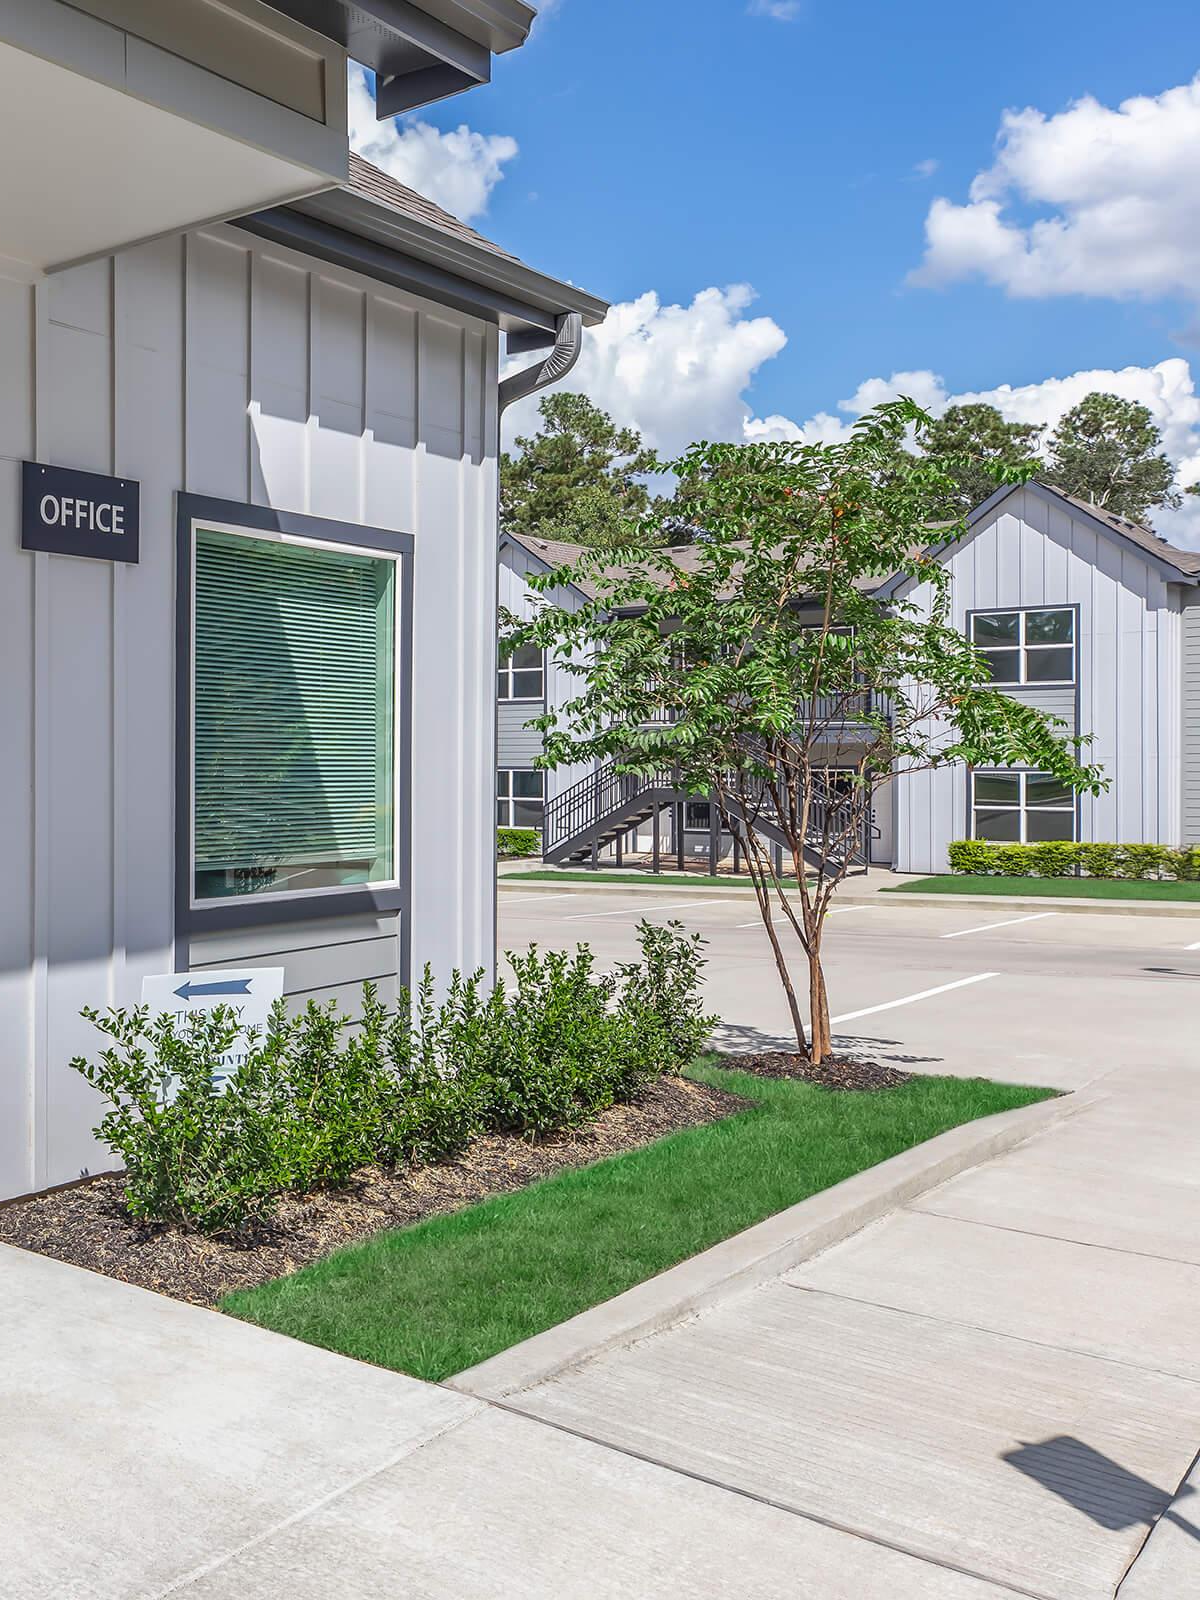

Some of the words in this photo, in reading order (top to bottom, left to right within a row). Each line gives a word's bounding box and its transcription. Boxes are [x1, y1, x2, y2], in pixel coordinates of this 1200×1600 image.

[40, 494, 125, 535] OFFICE
[174, 1008, 207, 1025] THIS
[172, 1029, 197, 1040] YOU
[236, 1023, 263, 1034] OME
